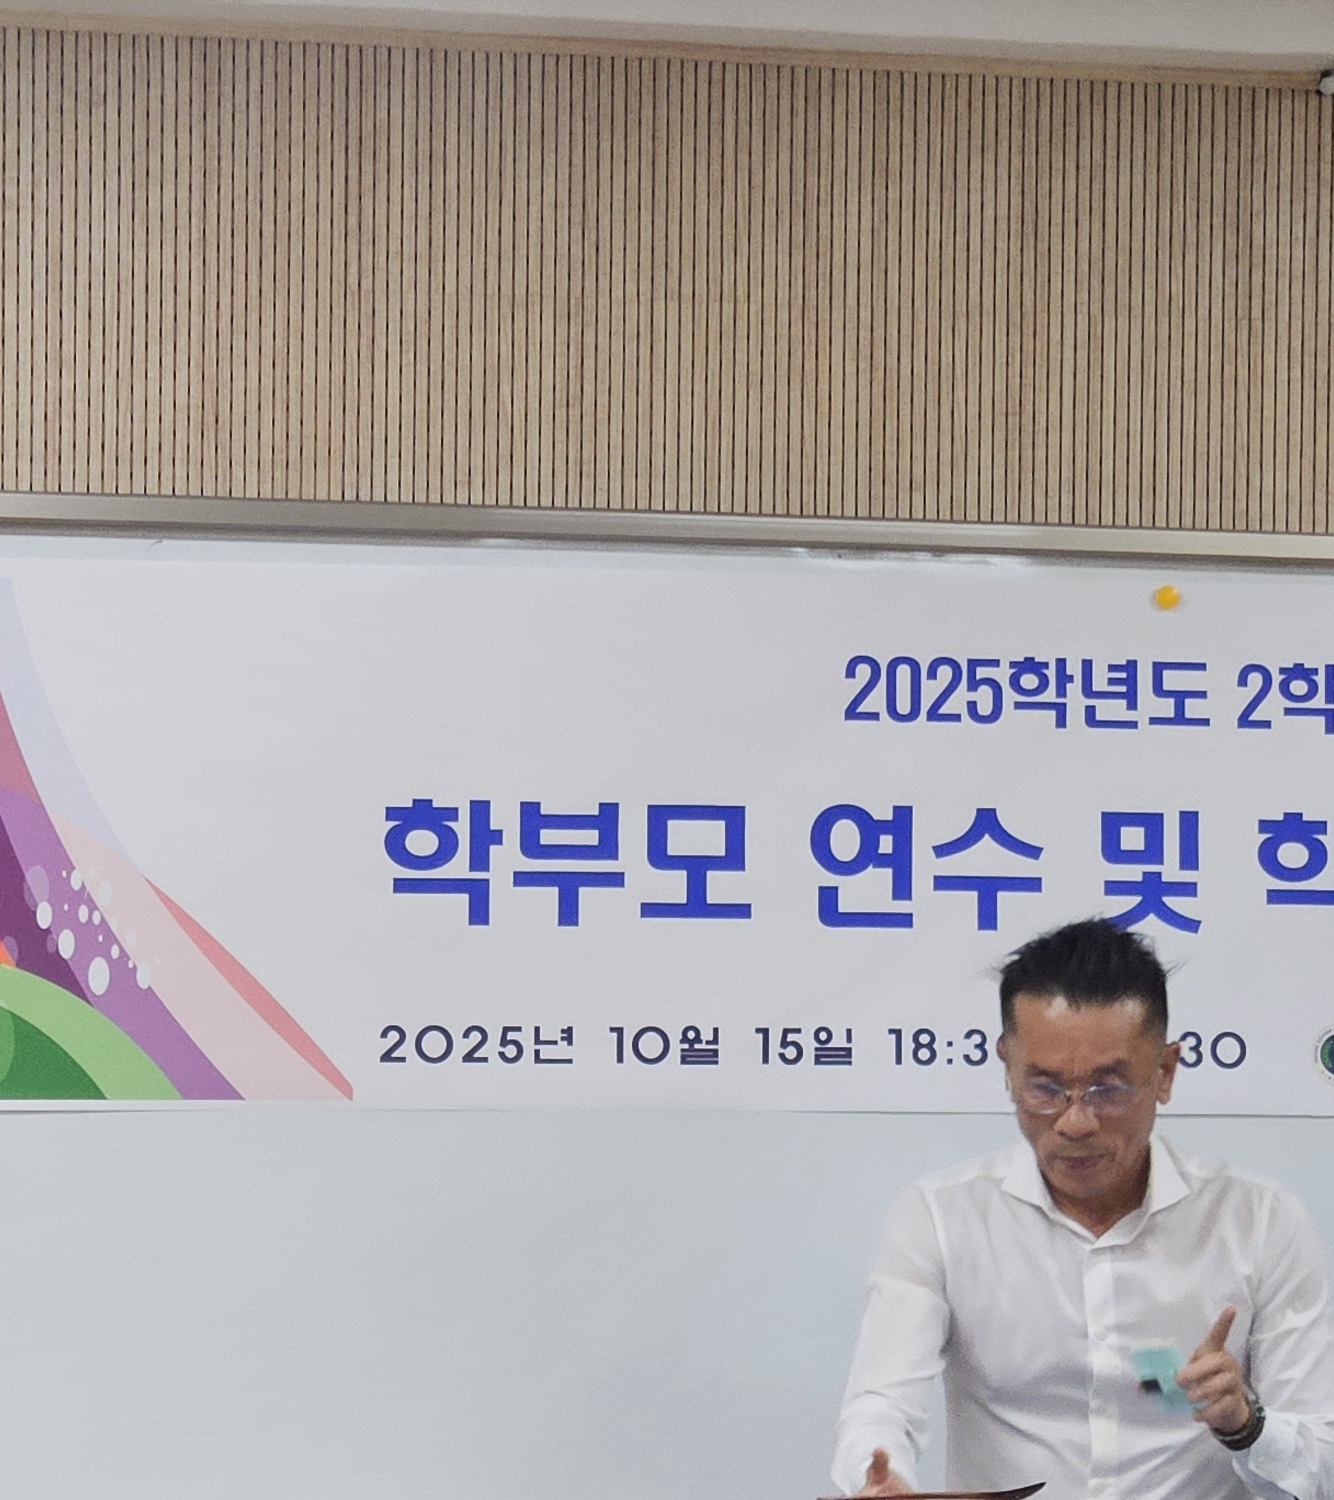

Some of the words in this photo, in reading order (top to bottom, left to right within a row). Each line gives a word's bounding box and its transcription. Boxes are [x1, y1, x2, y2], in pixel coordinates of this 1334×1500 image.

[843, 654, 1211, 730] 2025학년도
[383, 798, 753, 928] 학부모
[809, 803, 1044, 932] 연수
[1100, 810, 1202, 934] 및
[379, 1024, 575, 1065] 2025년
[608, 1024, 720, 1066] 10월
[754, 1025, 854, 1067] 15일
[887, 1027, 989, 1067] 18:3
[1178, 1030, 1247, 1070] 30
